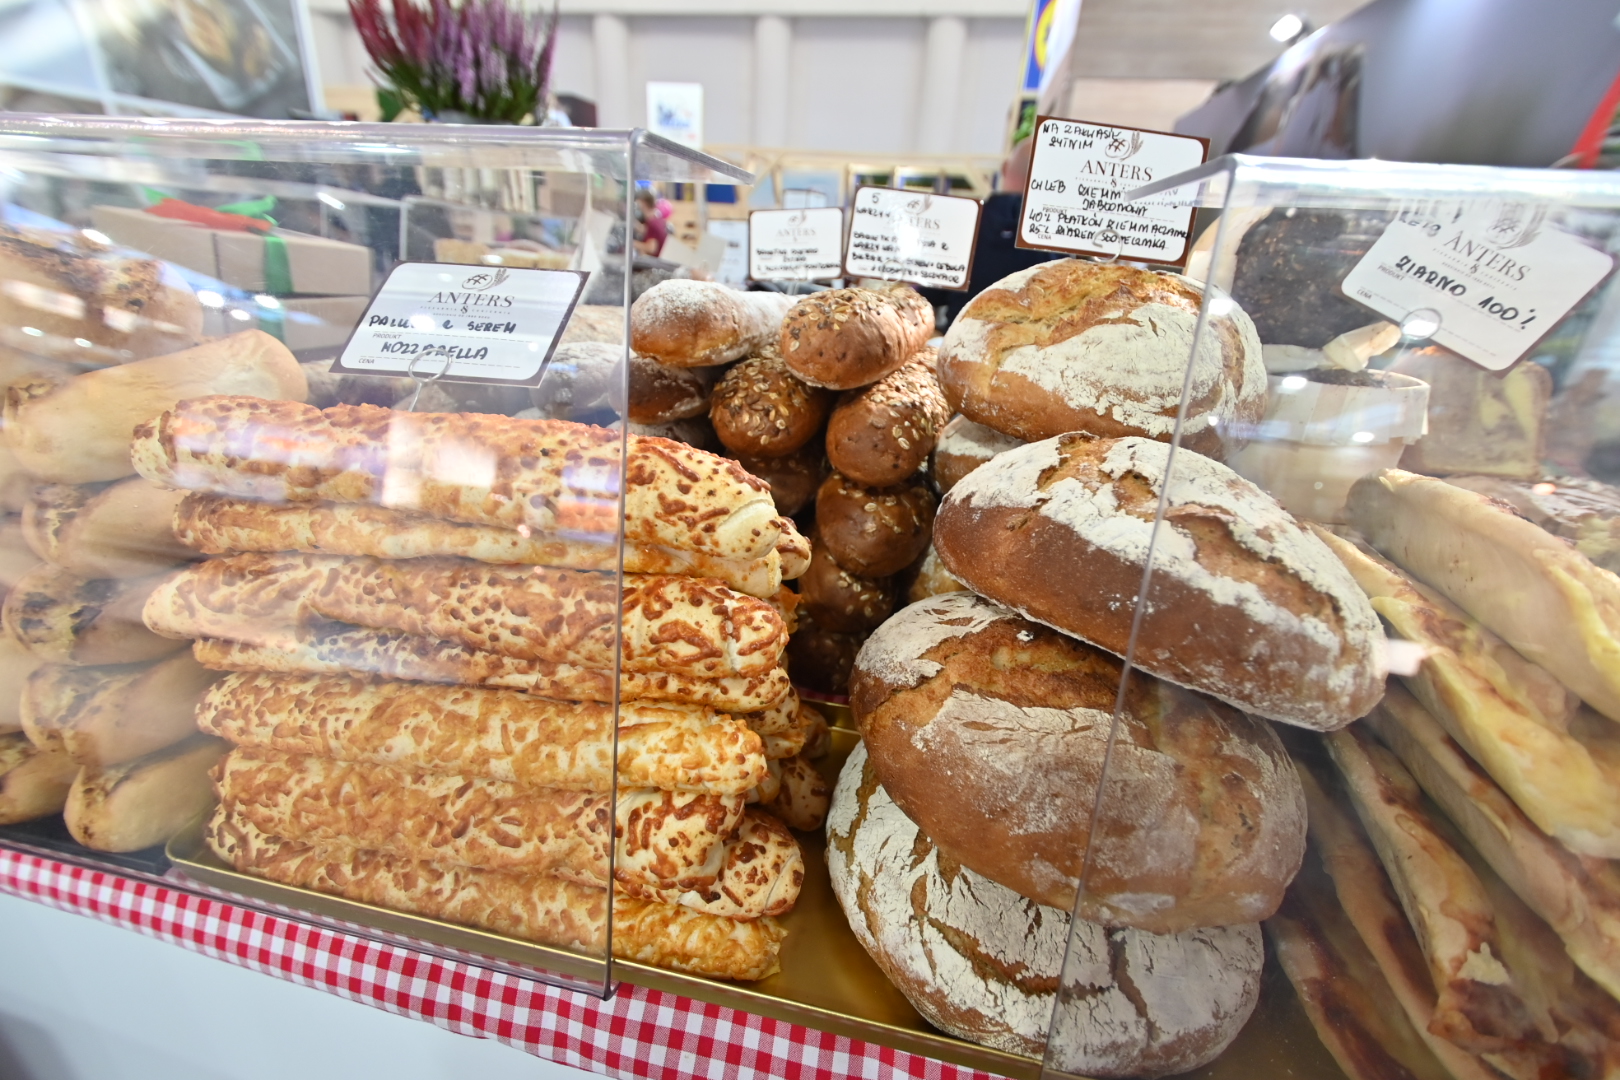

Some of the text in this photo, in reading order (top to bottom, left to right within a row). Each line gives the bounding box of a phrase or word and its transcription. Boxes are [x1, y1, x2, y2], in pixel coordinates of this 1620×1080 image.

[1043, 123, 1059, 134] NA
[1080, 159, 1153, 182] ANTERS
[1031, 179, 1066, 194] CHLEB
[872, 193, 881, 204] 5
[1443, 231, 1532, 283] ANTERS
[1377, 264, 1405, 282] PRODUKT
[1396, 255, 1467, 297] ZIARNO
[426, 291, 516, 309] ANTERS
[1356, 288, 1373, 301] CENA
[467, 321, 517, 334] SEREM
